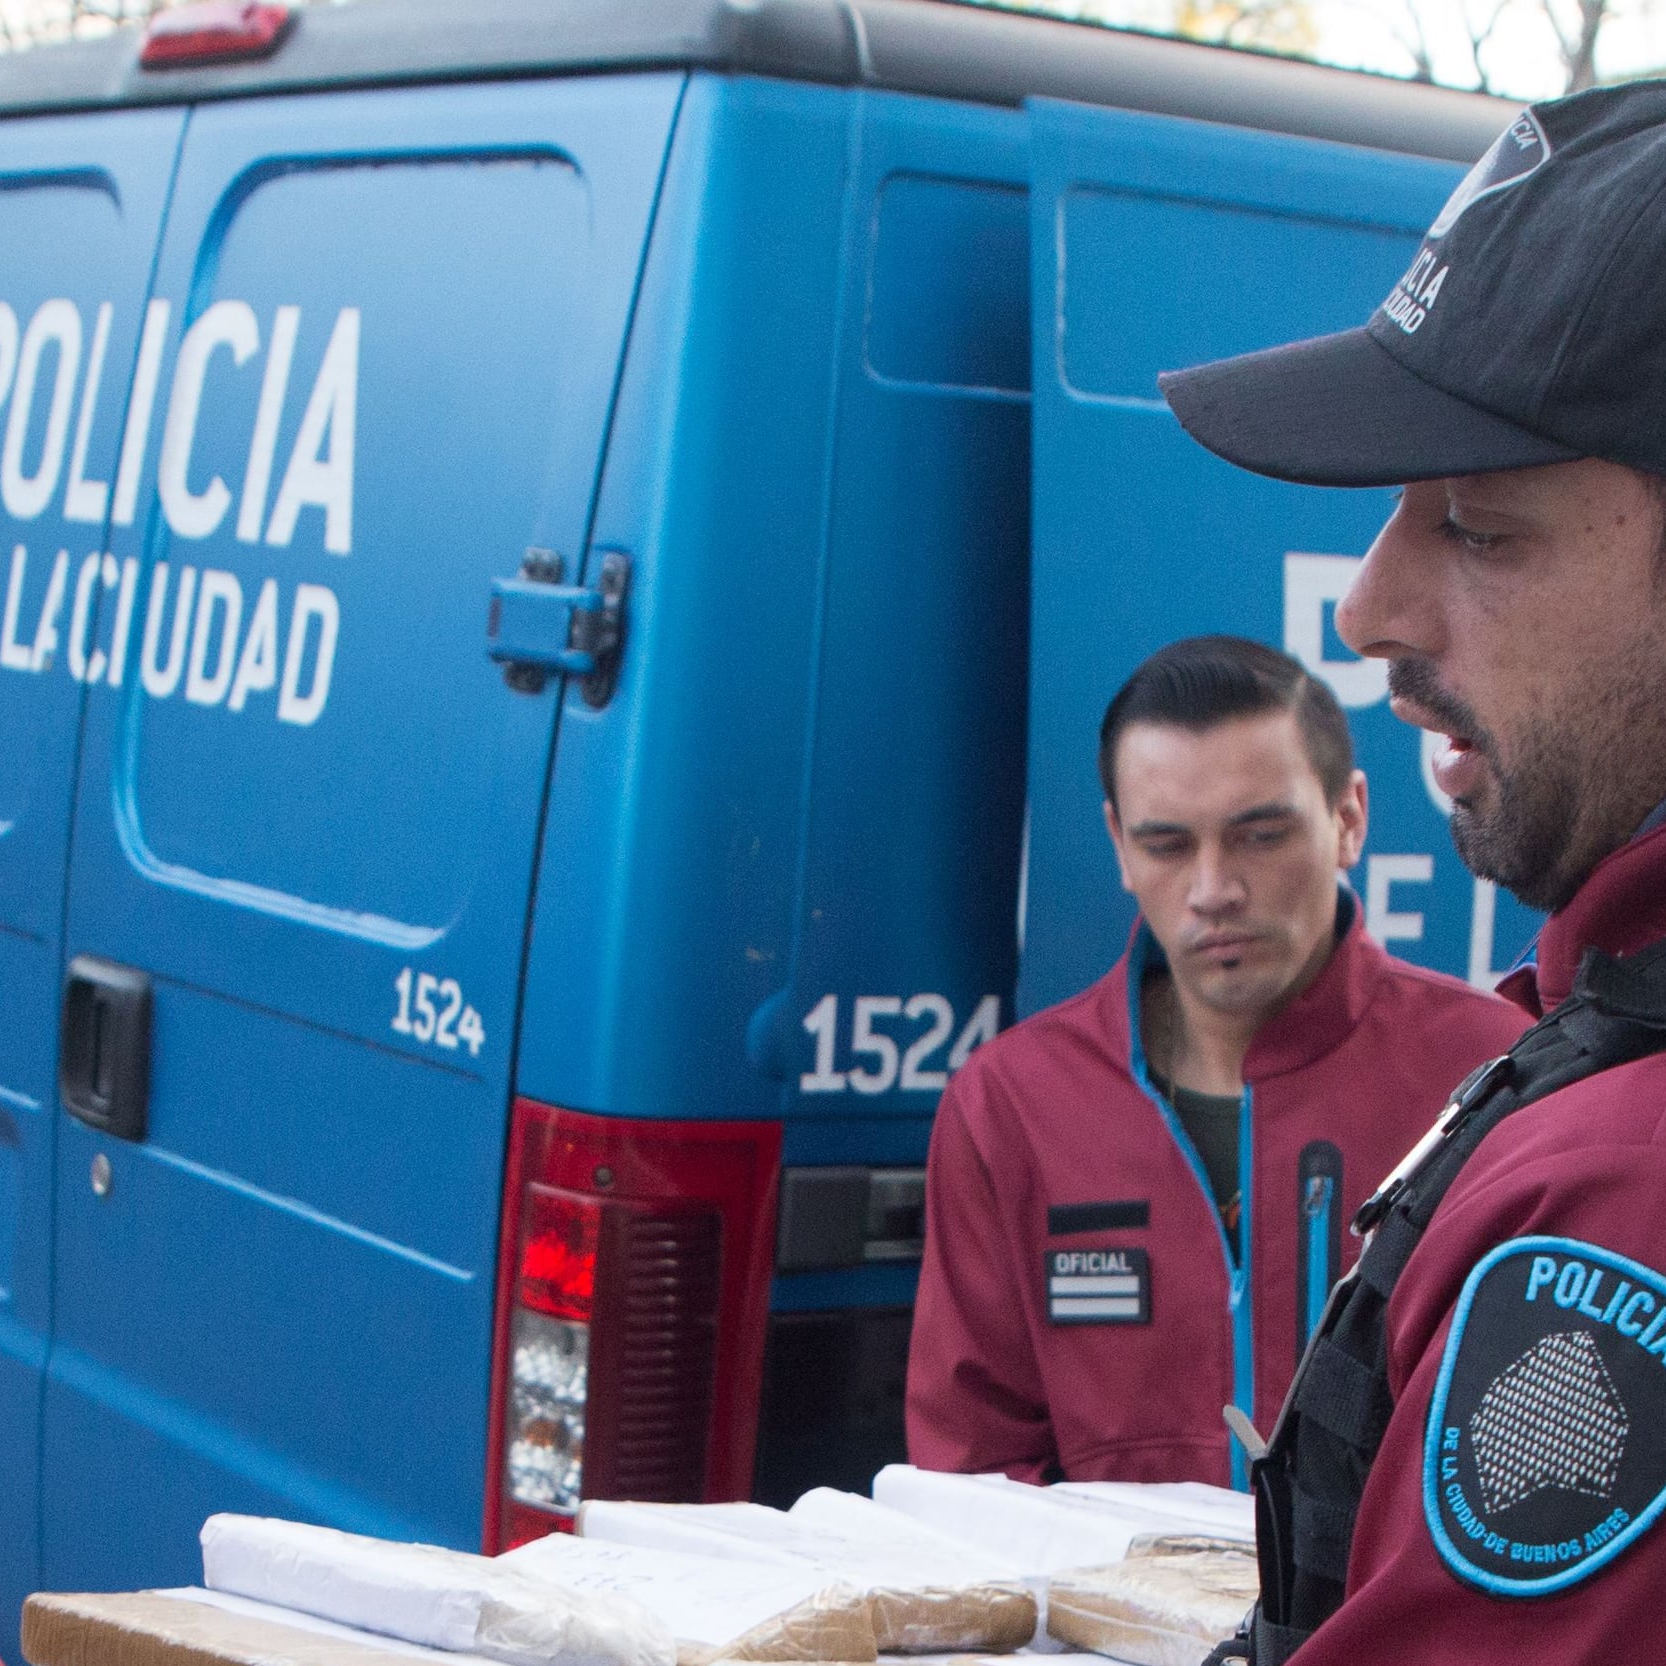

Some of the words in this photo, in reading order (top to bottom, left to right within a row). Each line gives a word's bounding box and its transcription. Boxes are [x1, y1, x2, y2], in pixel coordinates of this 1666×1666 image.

[66, 550, 340, 727] CIUDAD
[391, 966, 486, 1057] 1524
[799, 992, 1002, 1094] 1524
[1054, 1251, 1133, 1274] OFICIAL
[1442, 1426, 1461, 1451] DE
[1440, 1456, 1459, 1481] LA
[1583, 1507, 1631, 1551] AIRES
[1483, 1531, 1510, 1555] DE
[1509, 1538, 1583, 1564] BUENOS
